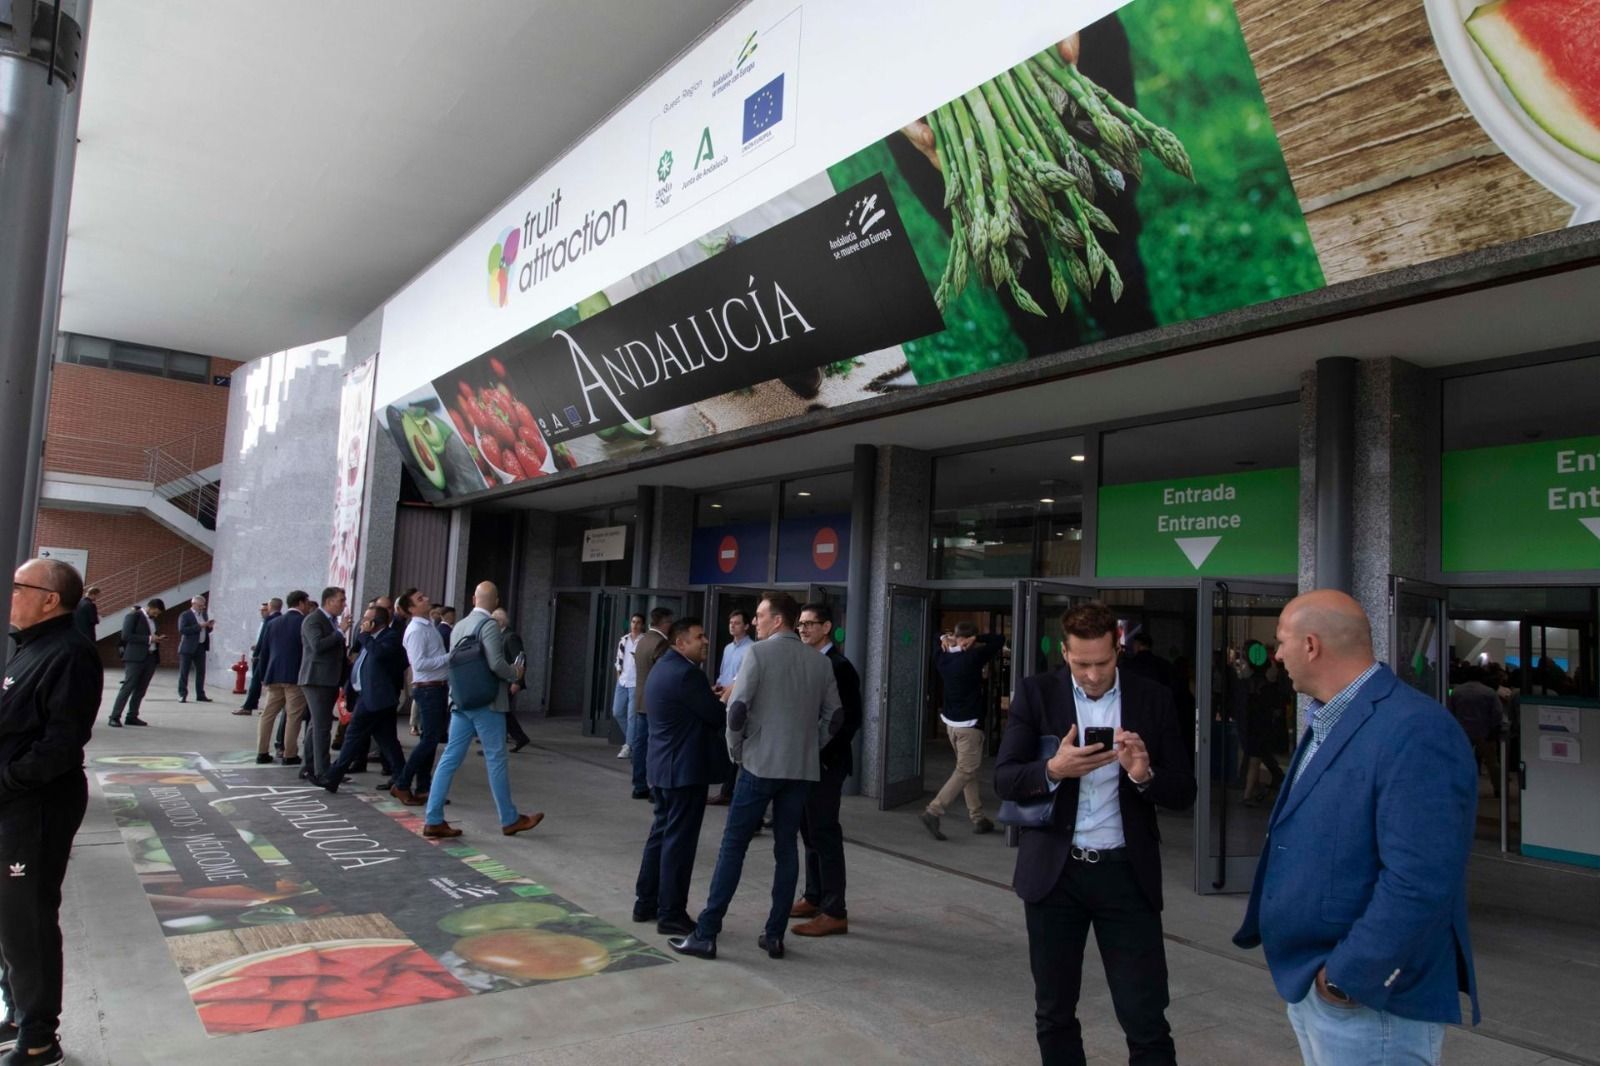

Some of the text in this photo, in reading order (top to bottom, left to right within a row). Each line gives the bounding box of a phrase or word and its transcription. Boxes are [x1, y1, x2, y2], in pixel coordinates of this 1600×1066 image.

[523, 187, 562, 249] fruit
[519, 199, 628, 293] attraction
[833, 228, 892, 260] se mueve con Europa
[552, 274, 816, 436] ANDALUCÍA
[1557, 450, 1600, 474] En
[1163, 483, 1236, 505] Entrada
[1157, 513, 1241, 532] Entrance
